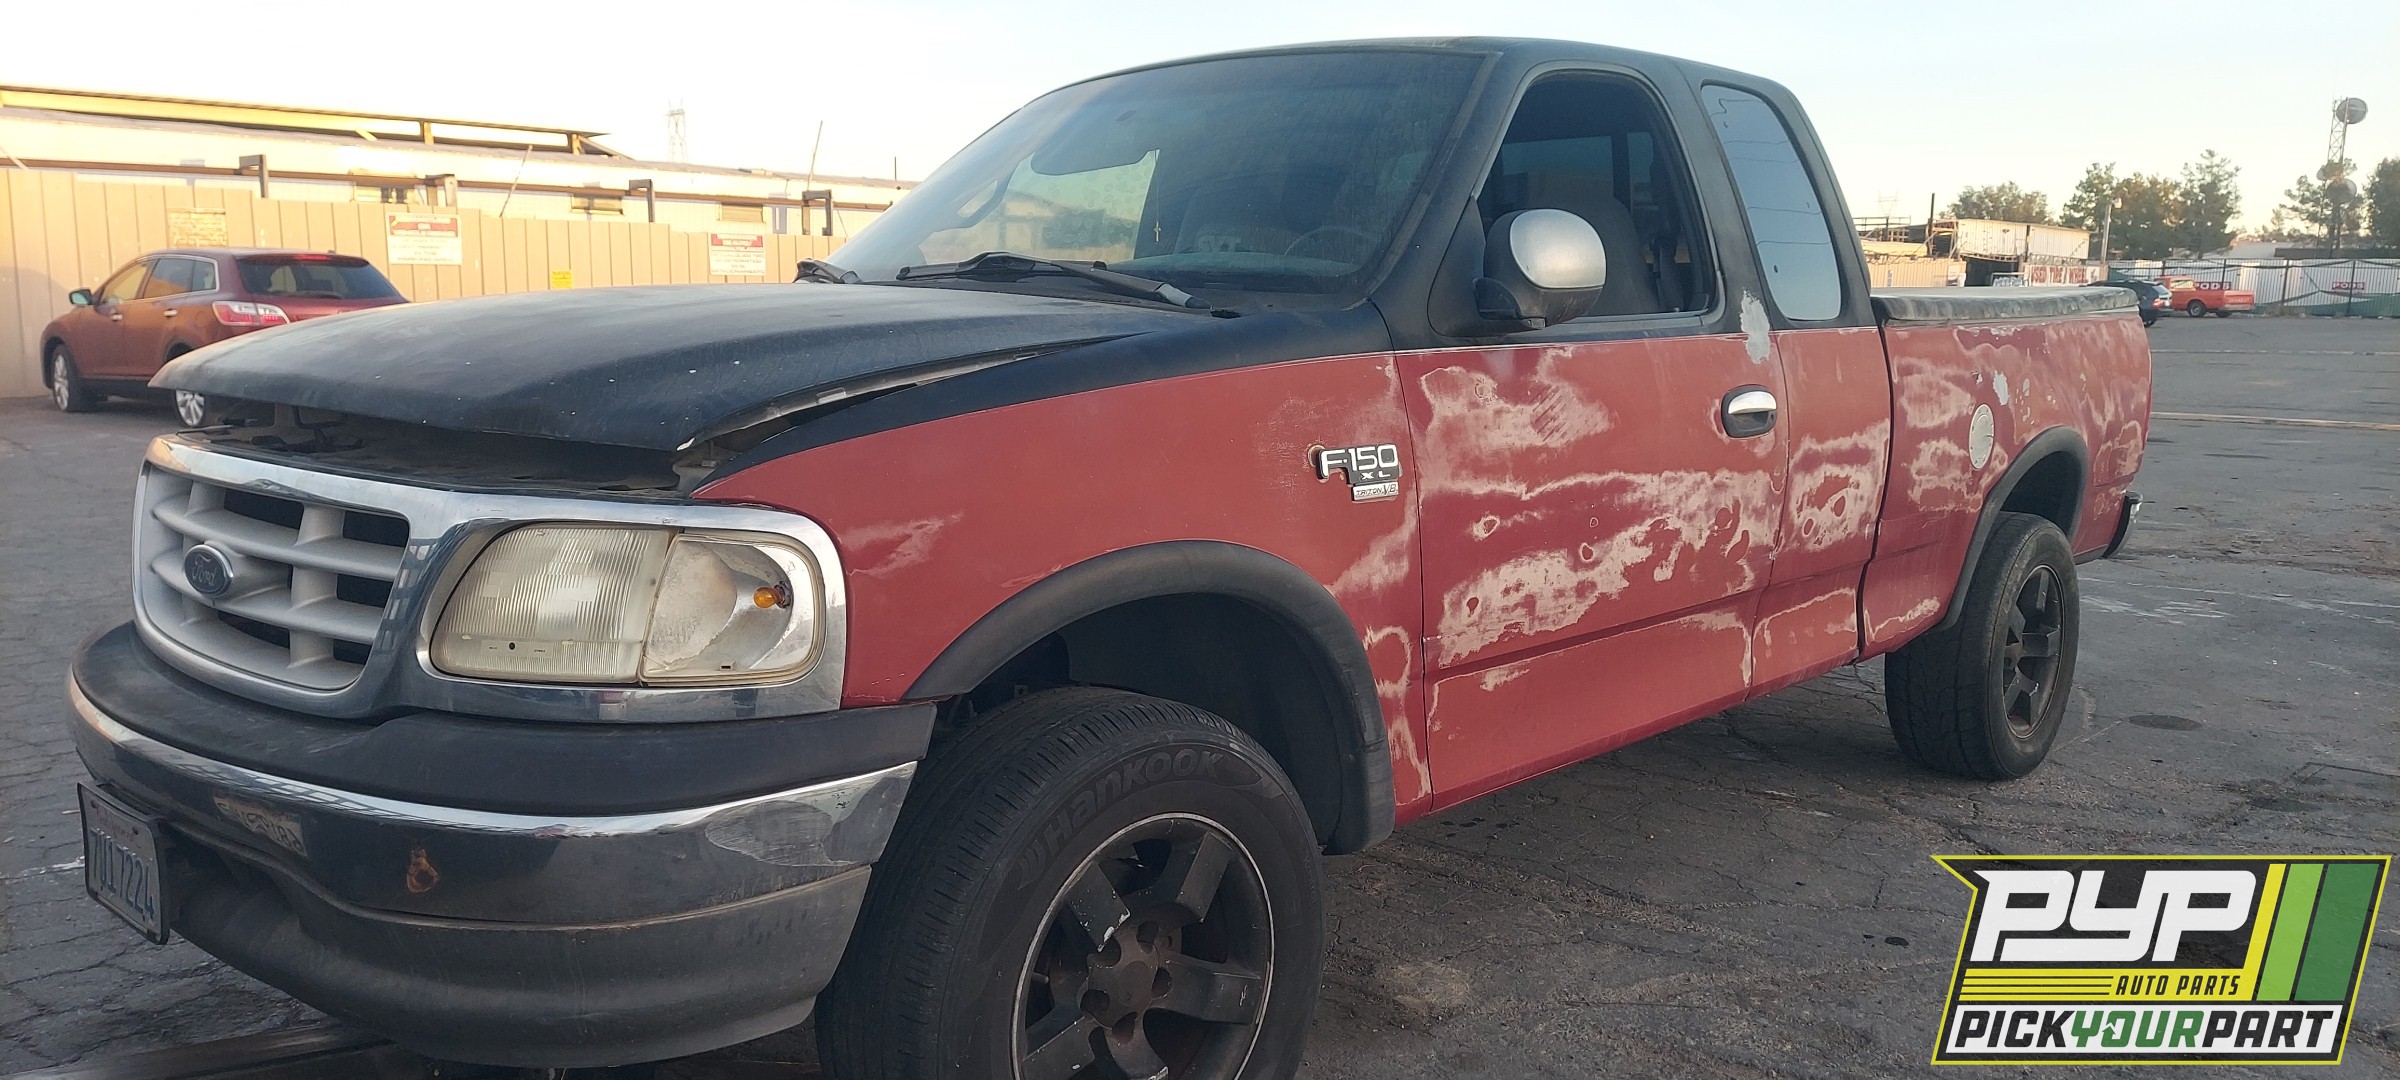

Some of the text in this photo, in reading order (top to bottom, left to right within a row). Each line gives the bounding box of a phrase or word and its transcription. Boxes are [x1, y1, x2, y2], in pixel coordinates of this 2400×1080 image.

[1361, 471, 1391, 481] XL
[1356, 483, 1397, 498] TRITON V8
[192, 555, 218, 587] Ford
[91, 830, 155, 920] 7U17224
